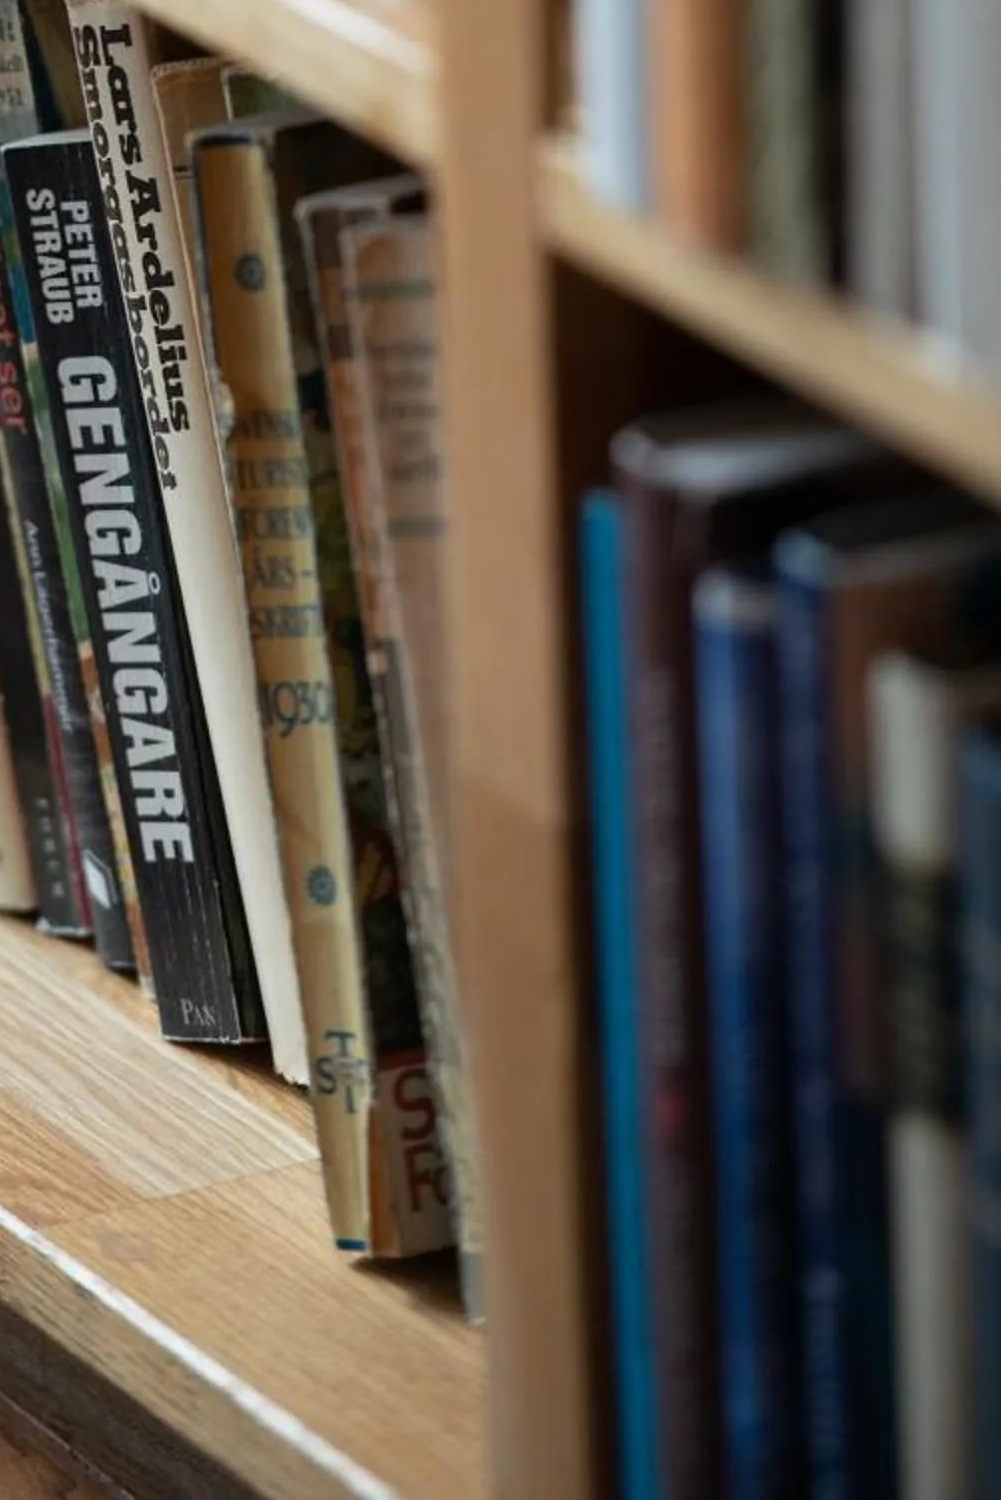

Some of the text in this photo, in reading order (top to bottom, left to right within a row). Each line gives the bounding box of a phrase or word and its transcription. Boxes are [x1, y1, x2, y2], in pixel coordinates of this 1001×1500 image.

[25, 187, 74, 326] STRAUB
[60, 199, 103, 310] PETER
[100, 23, 192, 435] Lars Ardelius
[57, 355, 195, 864] GENGÅNGARE
